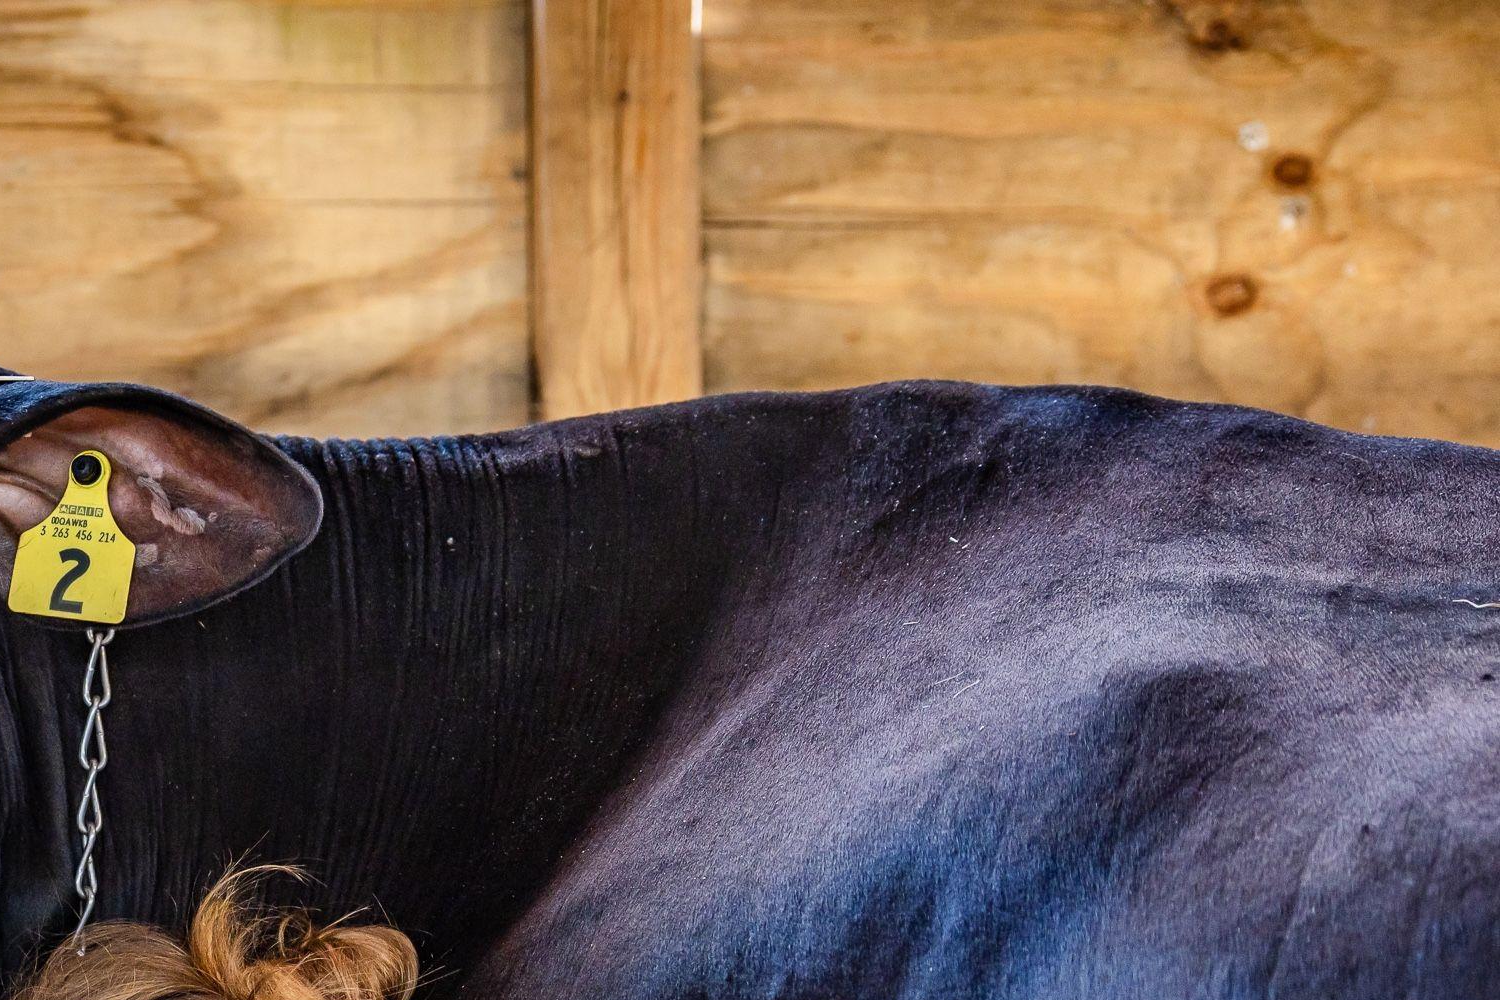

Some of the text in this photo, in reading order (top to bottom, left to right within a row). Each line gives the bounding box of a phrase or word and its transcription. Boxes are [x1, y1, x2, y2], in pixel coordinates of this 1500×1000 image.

[69, 505, 103, 517] FAIR
[40, 526, 116, 543] 3 263 456 214
[49, 548, 90, 614] 2
